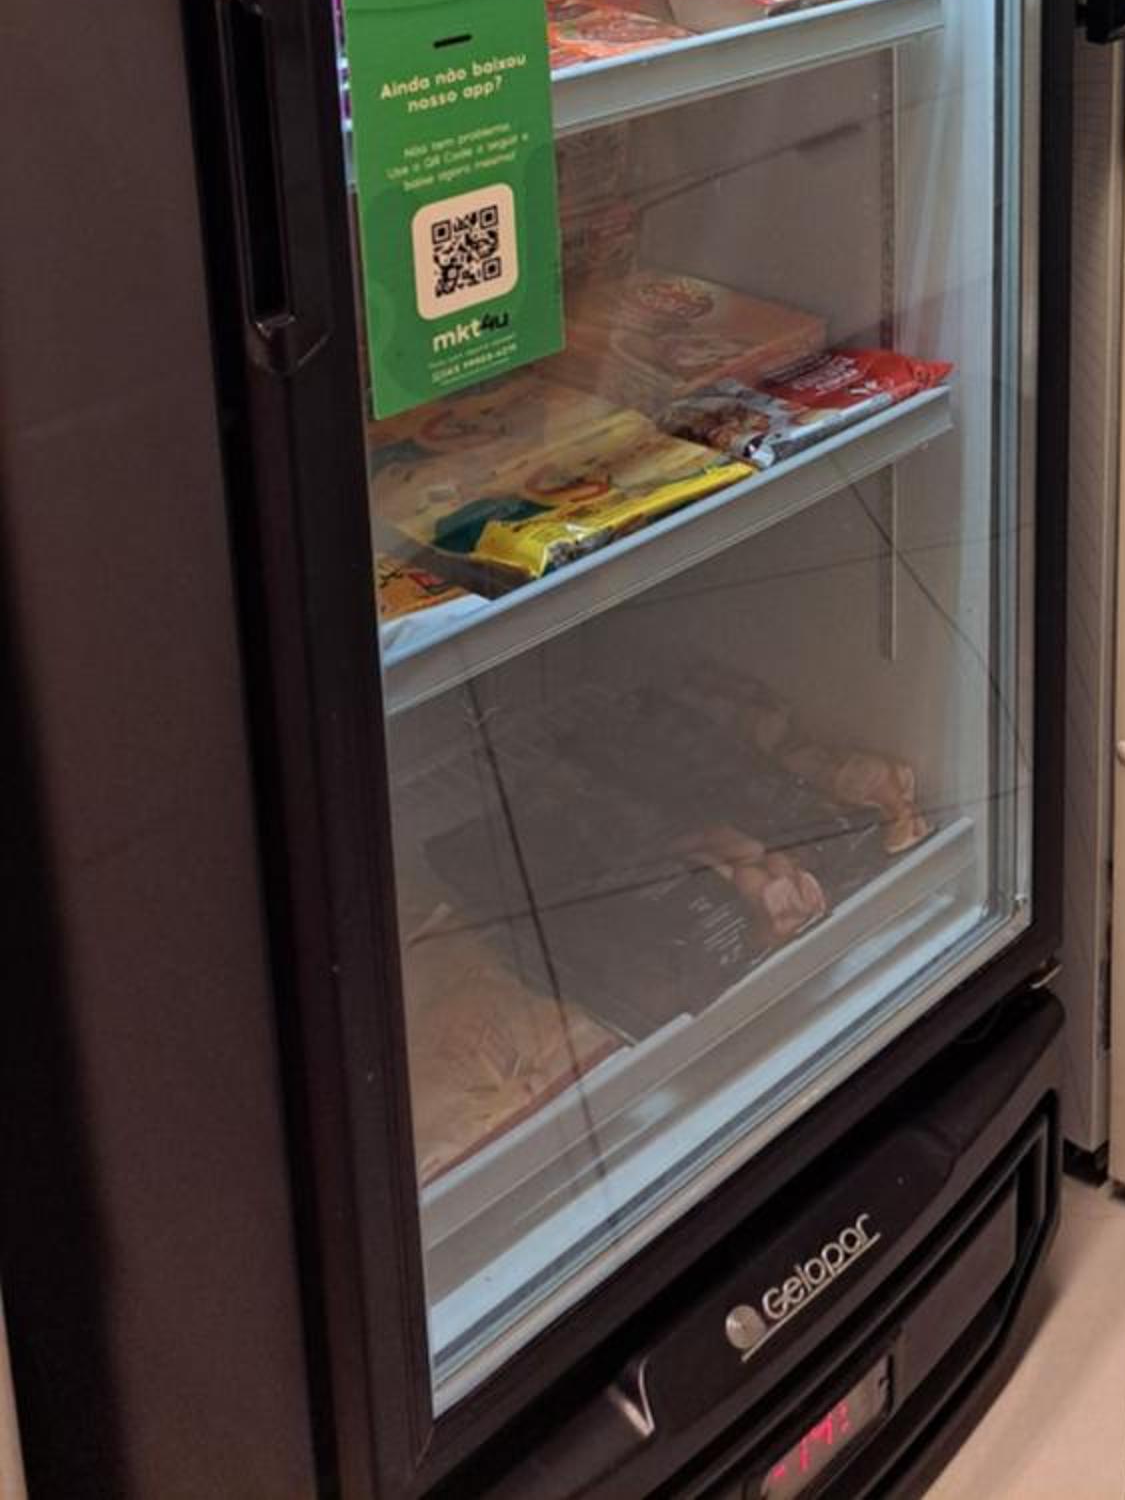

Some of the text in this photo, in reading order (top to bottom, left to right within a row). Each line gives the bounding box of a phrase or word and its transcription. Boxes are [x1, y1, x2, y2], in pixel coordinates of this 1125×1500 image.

[380, 53, 528, 100] Ainda não baixou
[408, 75, 504, 114] nosso app?
[433, 311, 510, 354] mkt4u
[761, 1212, 870, 1320] Gelopar
